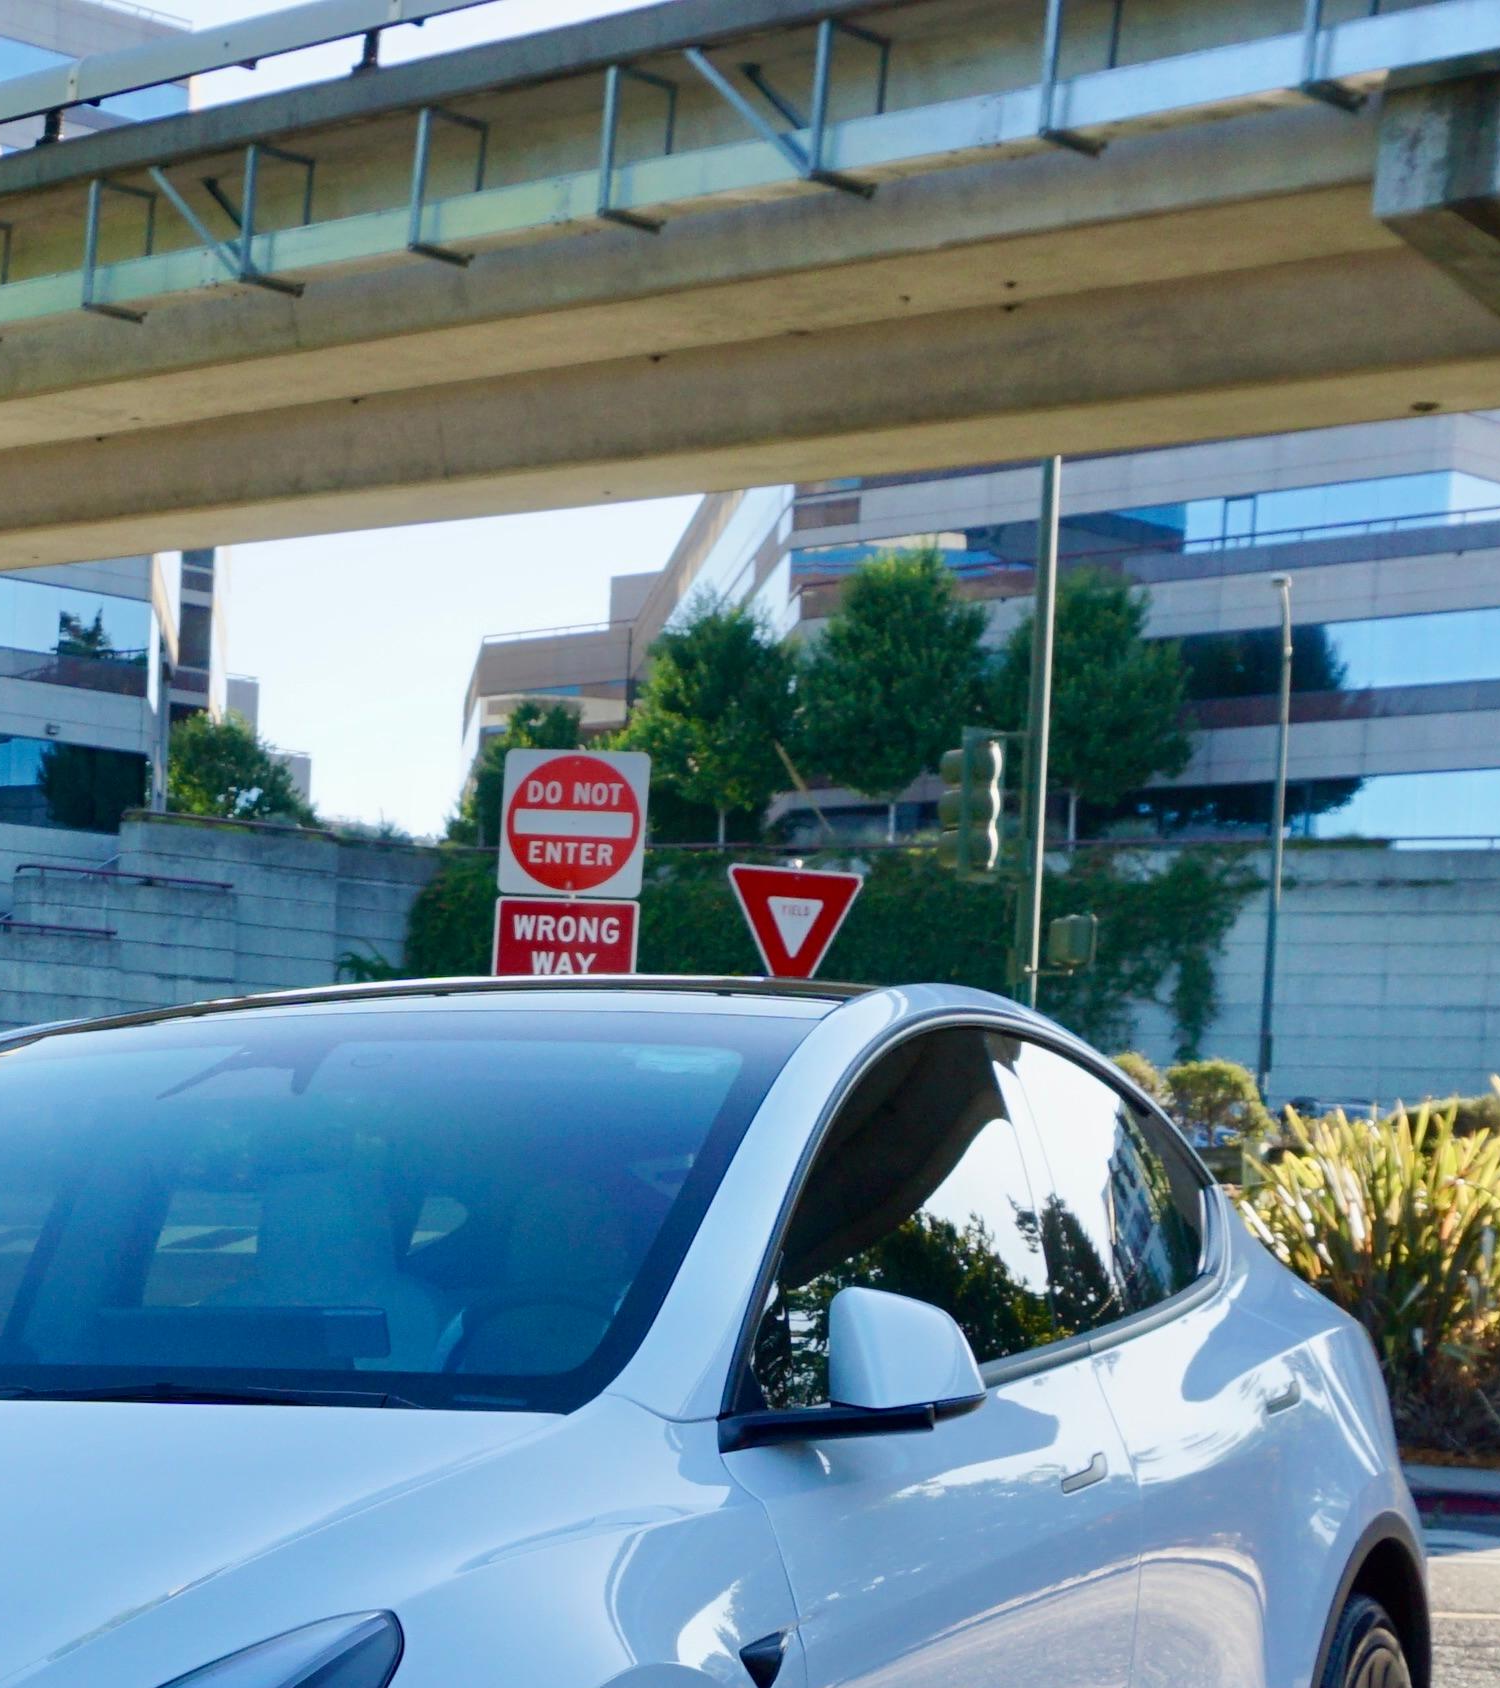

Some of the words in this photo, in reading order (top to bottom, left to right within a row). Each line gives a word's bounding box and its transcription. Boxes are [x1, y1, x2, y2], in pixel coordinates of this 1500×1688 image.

[526, 780, 563, 804] DO
[573, 782, 624, 806] NOT
[528, 841, 614, 866] ENTER
[513, 914, 620, 944] WRONG
[531, 951, 597, 975] WAY
